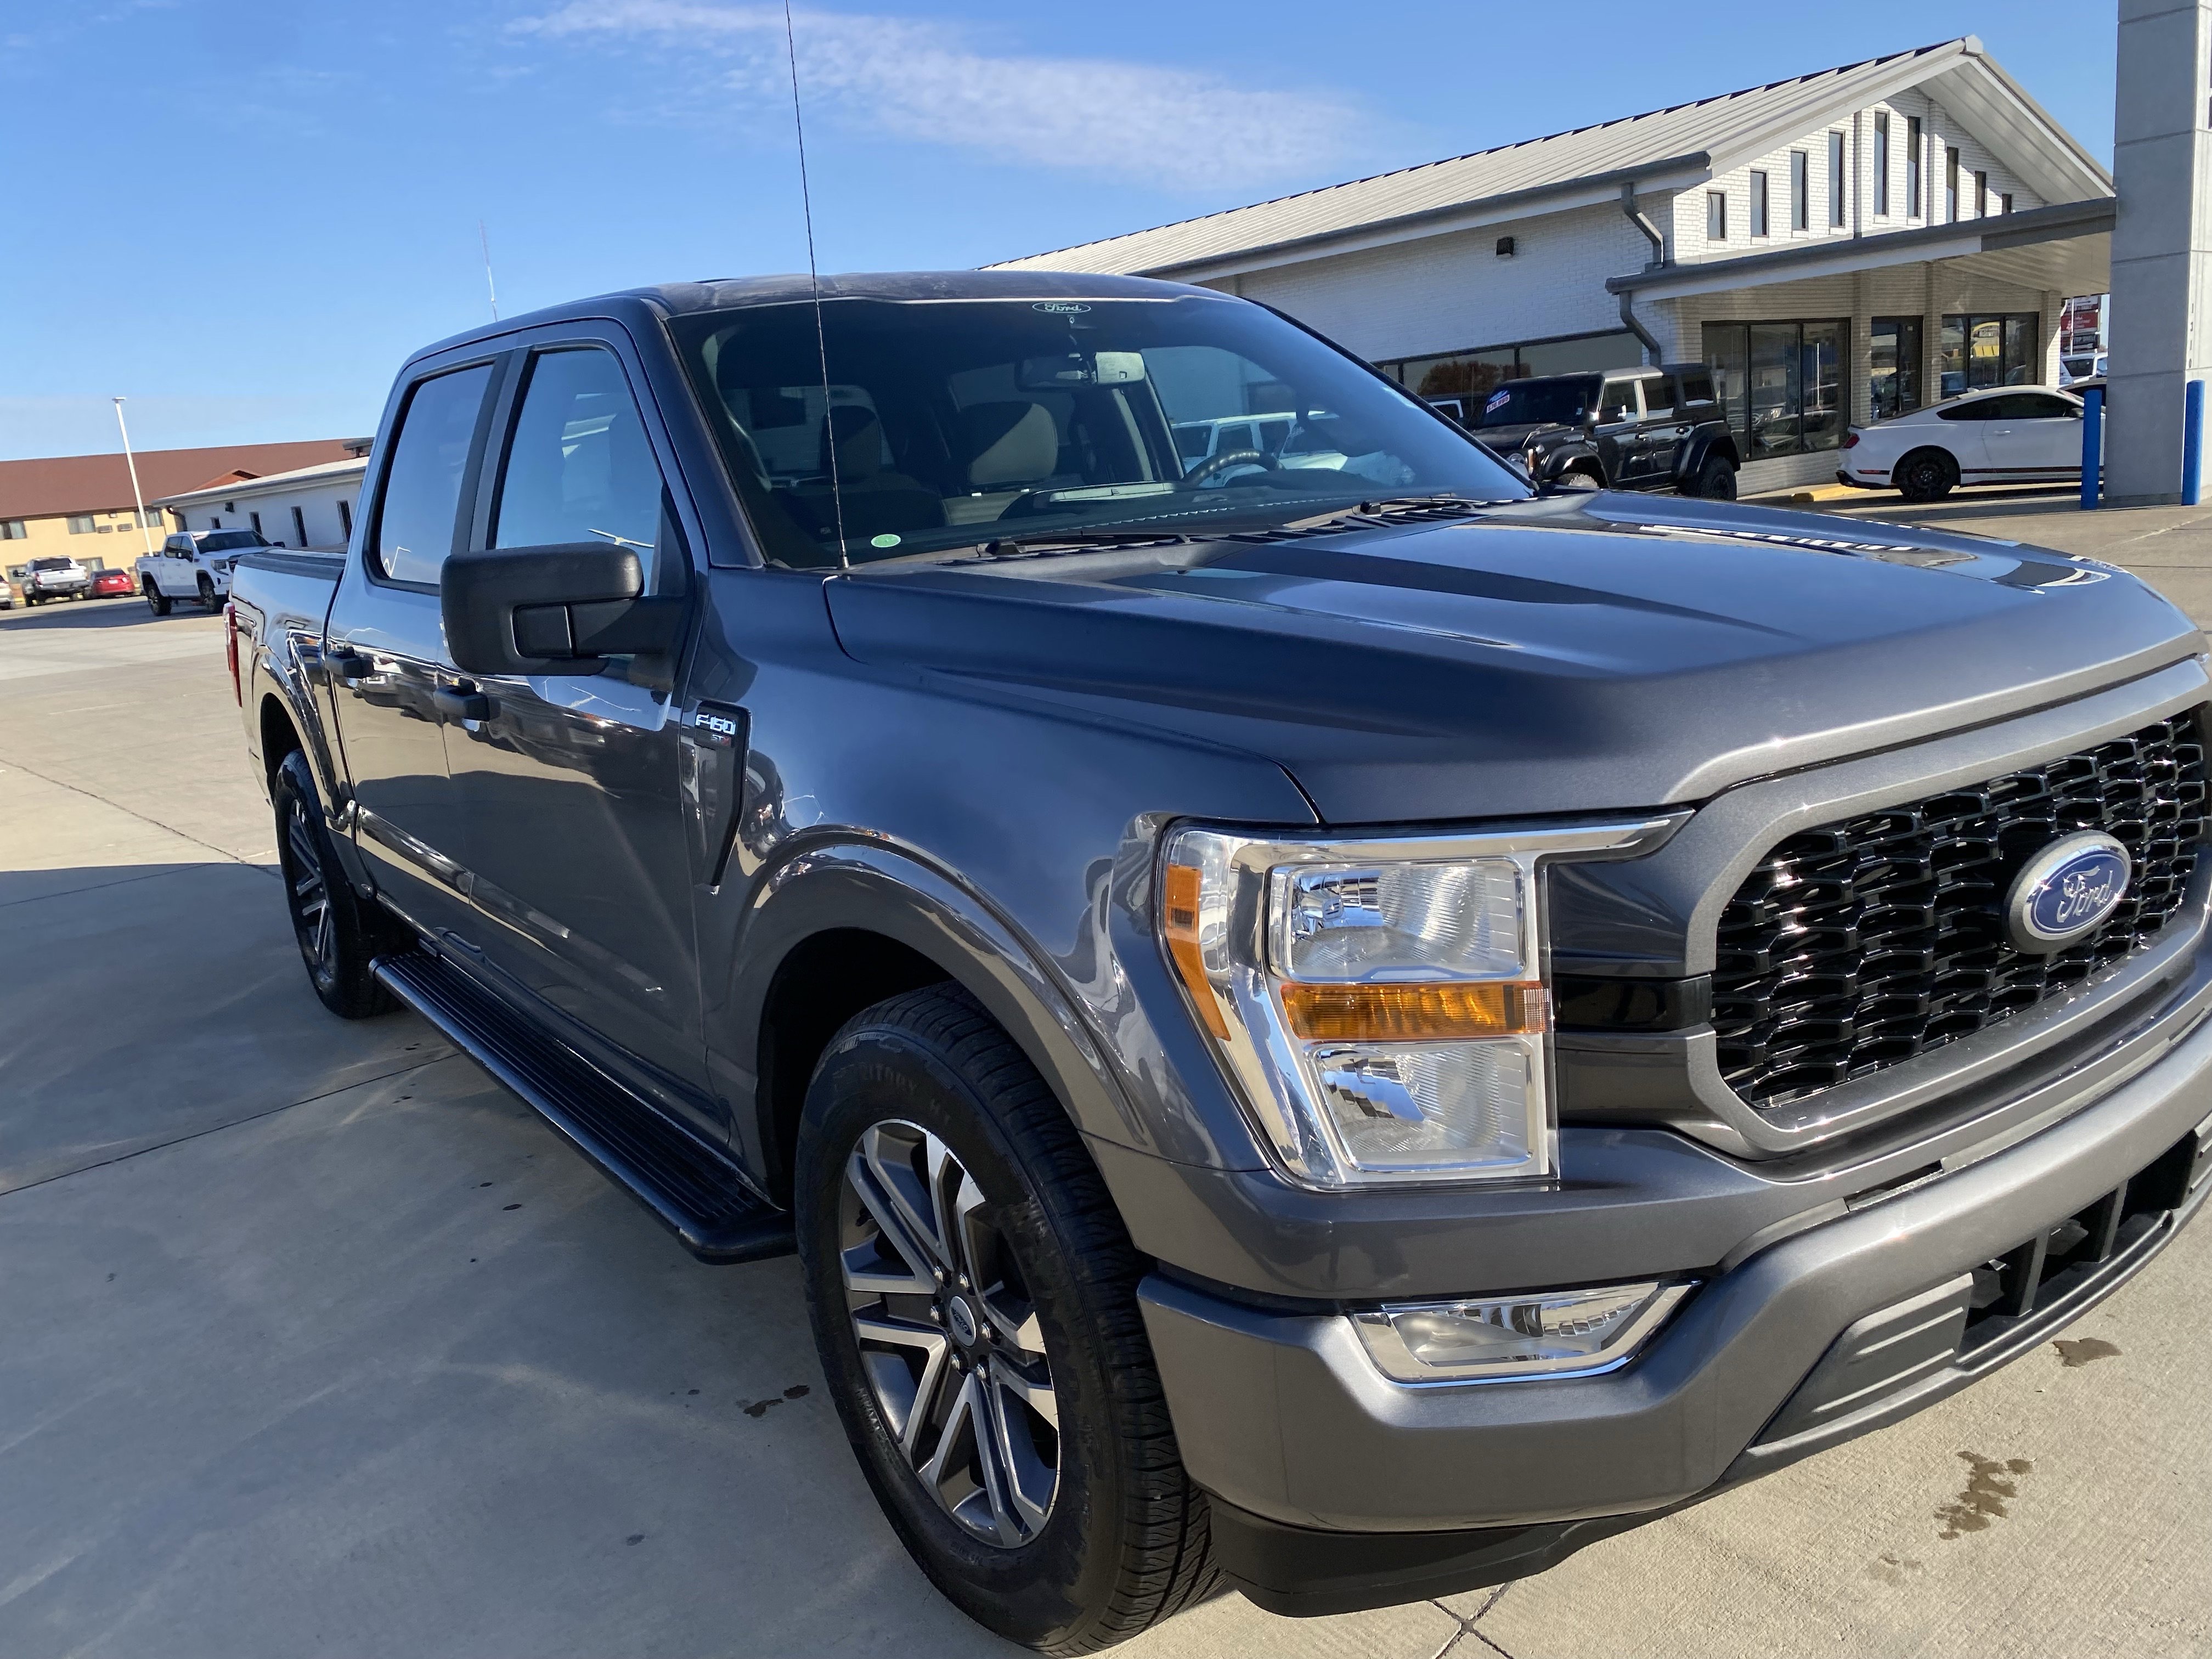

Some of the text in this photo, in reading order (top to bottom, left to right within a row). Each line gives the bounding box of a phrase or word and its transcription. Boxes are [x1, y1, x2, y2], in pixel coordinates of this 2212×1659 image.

[1044, 303, 1081, 311] Ford
[695, 714, 736, 735] F-150
[711, 734, 731, 746] STX
[2056, 865, 2113, 923] Ford
[832, 1062, 918, 1096] RITORY
